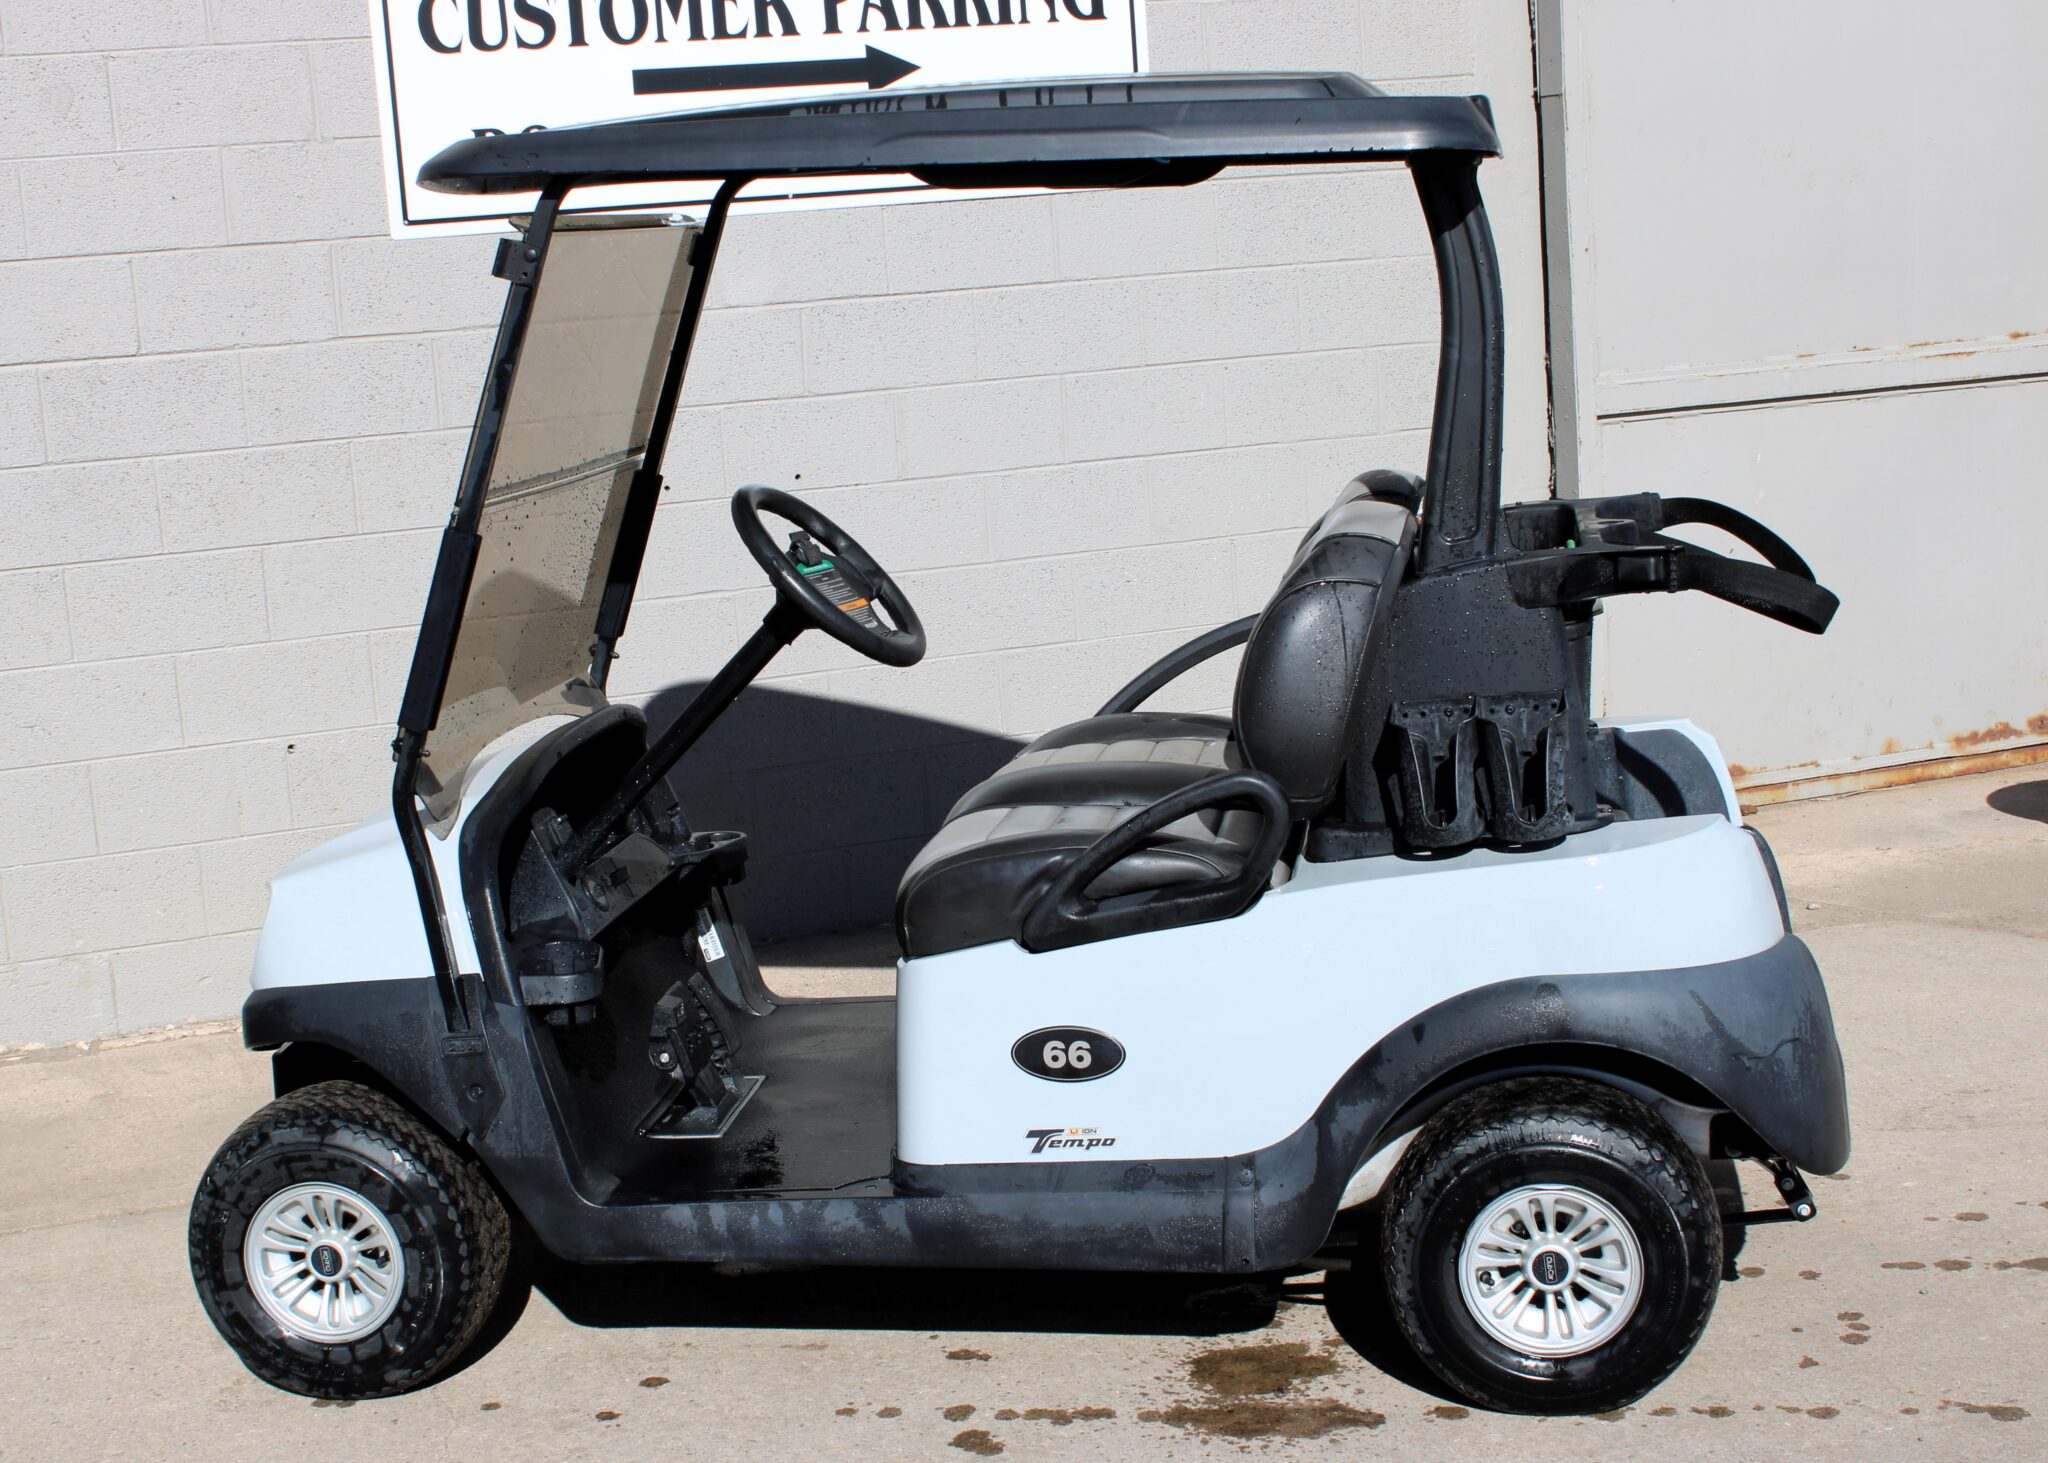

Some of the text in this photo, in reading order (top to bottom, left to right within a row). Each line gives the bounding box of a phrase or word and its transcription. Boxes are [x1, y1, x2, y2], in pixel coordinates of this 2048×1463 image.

[418, 0, 800, 54] CUSTOMER
[1043, 1040, 1092, 1069] 66
[1026, 1129, 1116, 1154] Tempo
